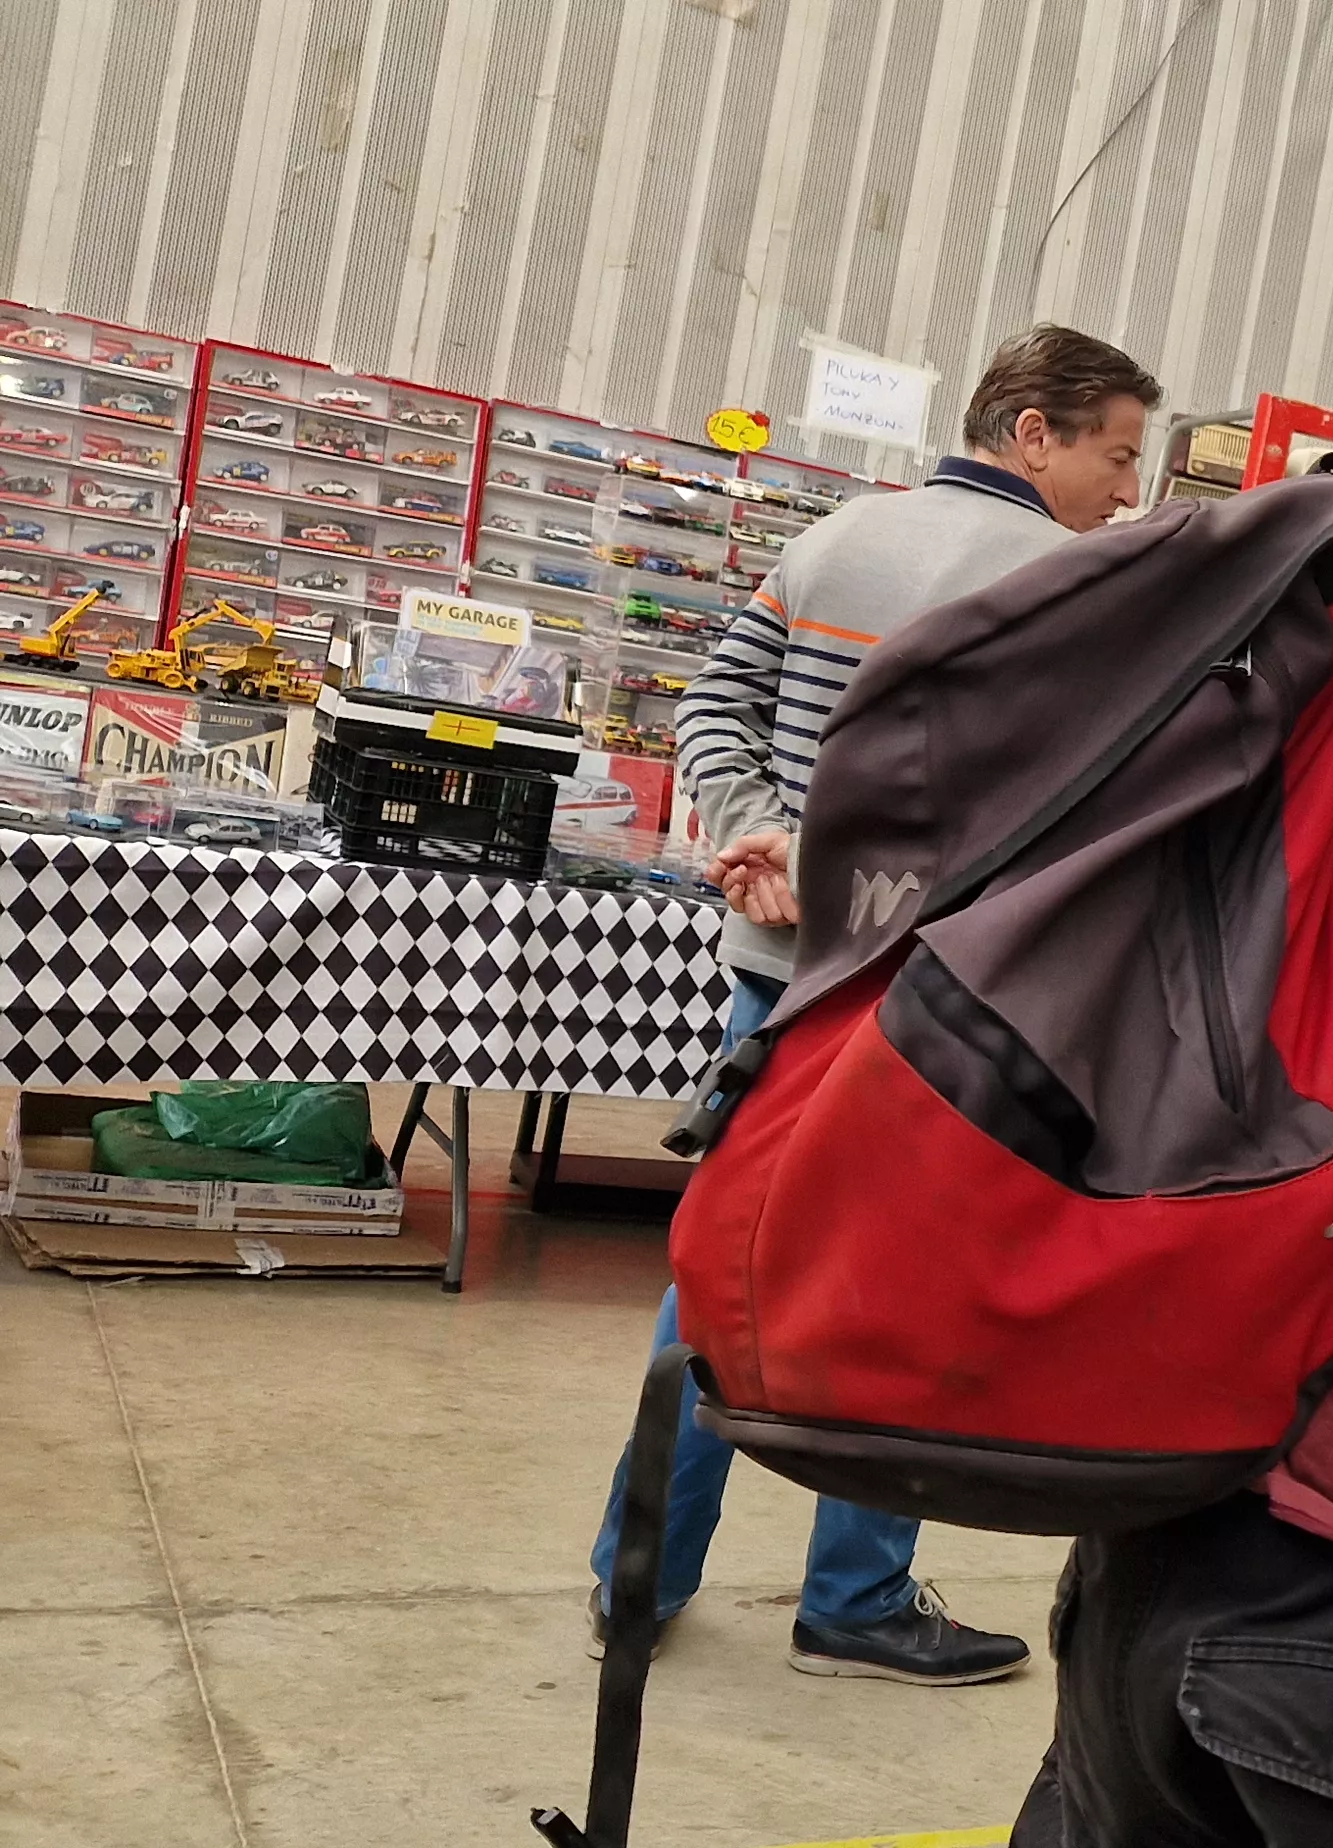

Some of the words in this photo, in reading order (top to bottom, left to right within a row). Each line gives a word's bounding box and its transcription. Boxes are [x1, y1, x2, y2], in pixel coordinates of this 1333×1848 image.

[416, 599, 444, 616] MY
[448, 606, 519, 631] GARAGE
[94, 723, 276, 797] CHAMPION
